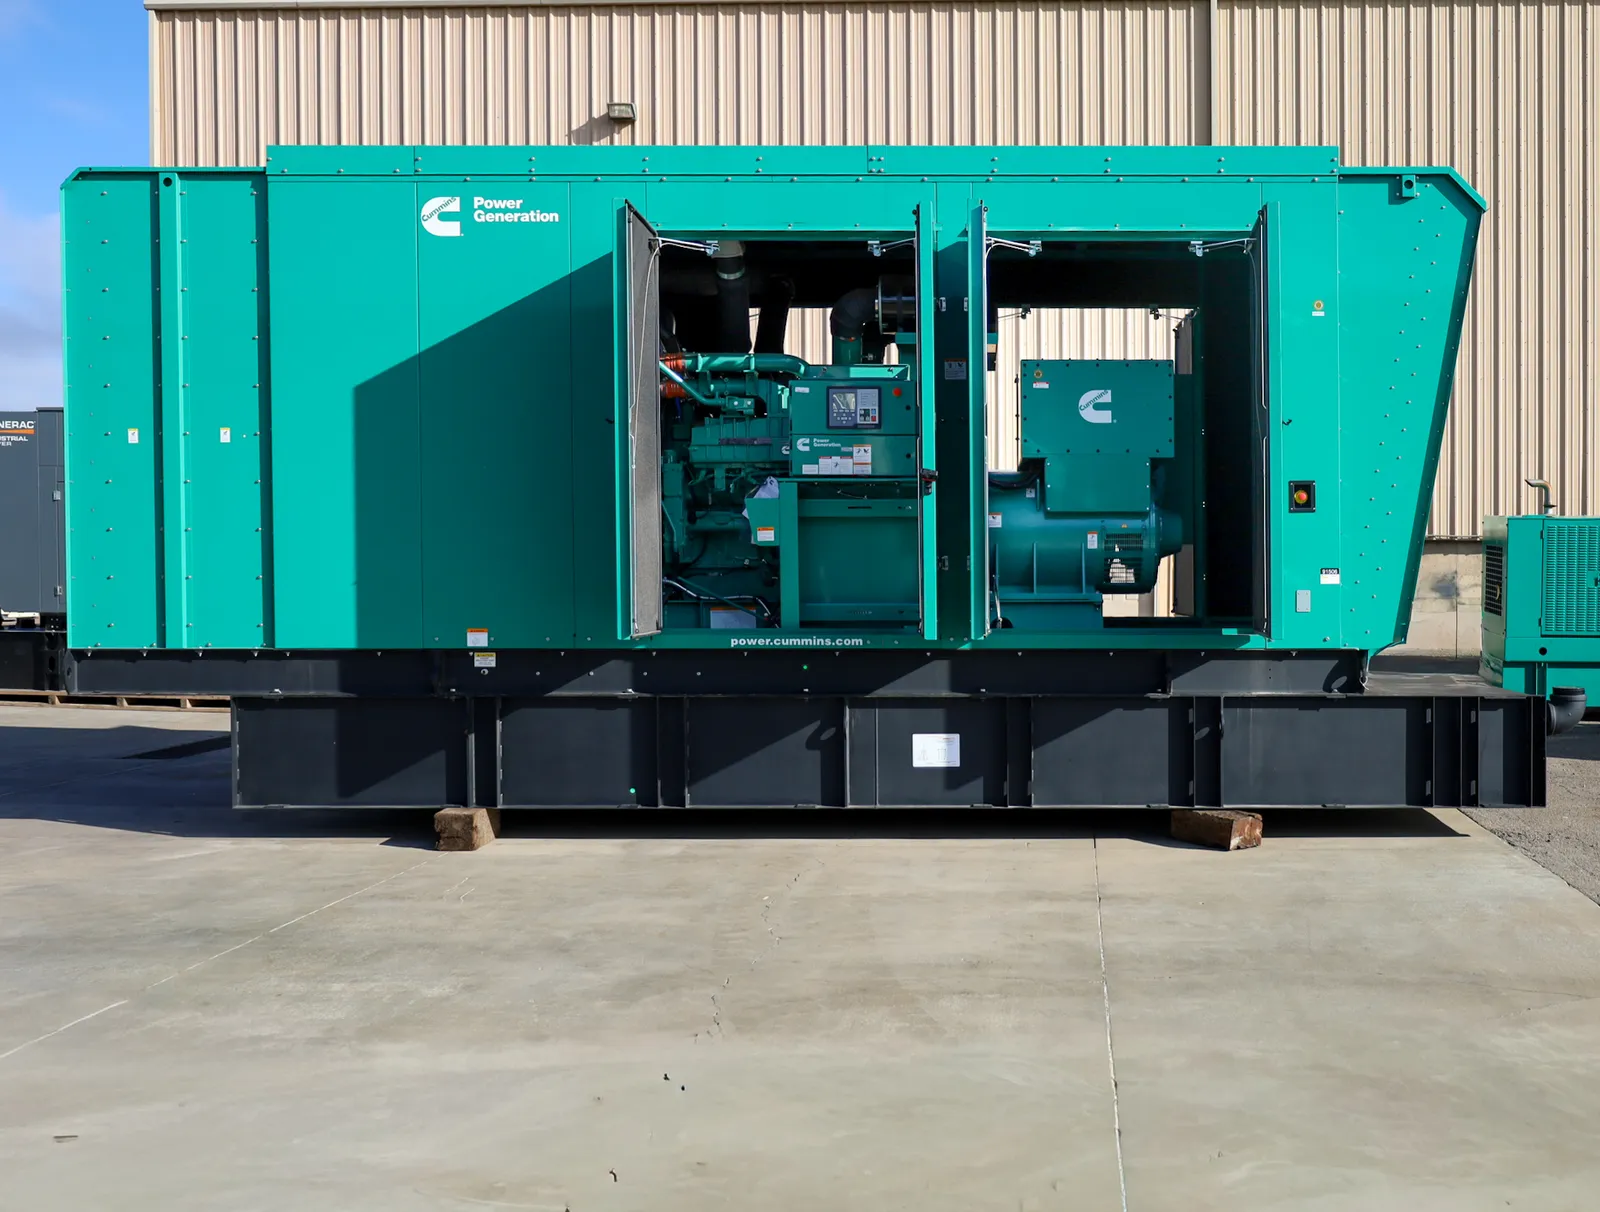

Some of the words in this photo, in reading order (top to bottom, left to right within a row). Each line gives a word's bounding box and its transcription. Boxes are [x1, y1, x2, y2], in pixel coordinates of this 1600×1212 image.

[421, 196, 457, 222] Cummins
[473, 196, 523, 209] Power
[473, 210, 559, 222] Generation
[1079, 389, 1109, 411] Cummins
[730, 636, 863, 647] power.cummins.com
